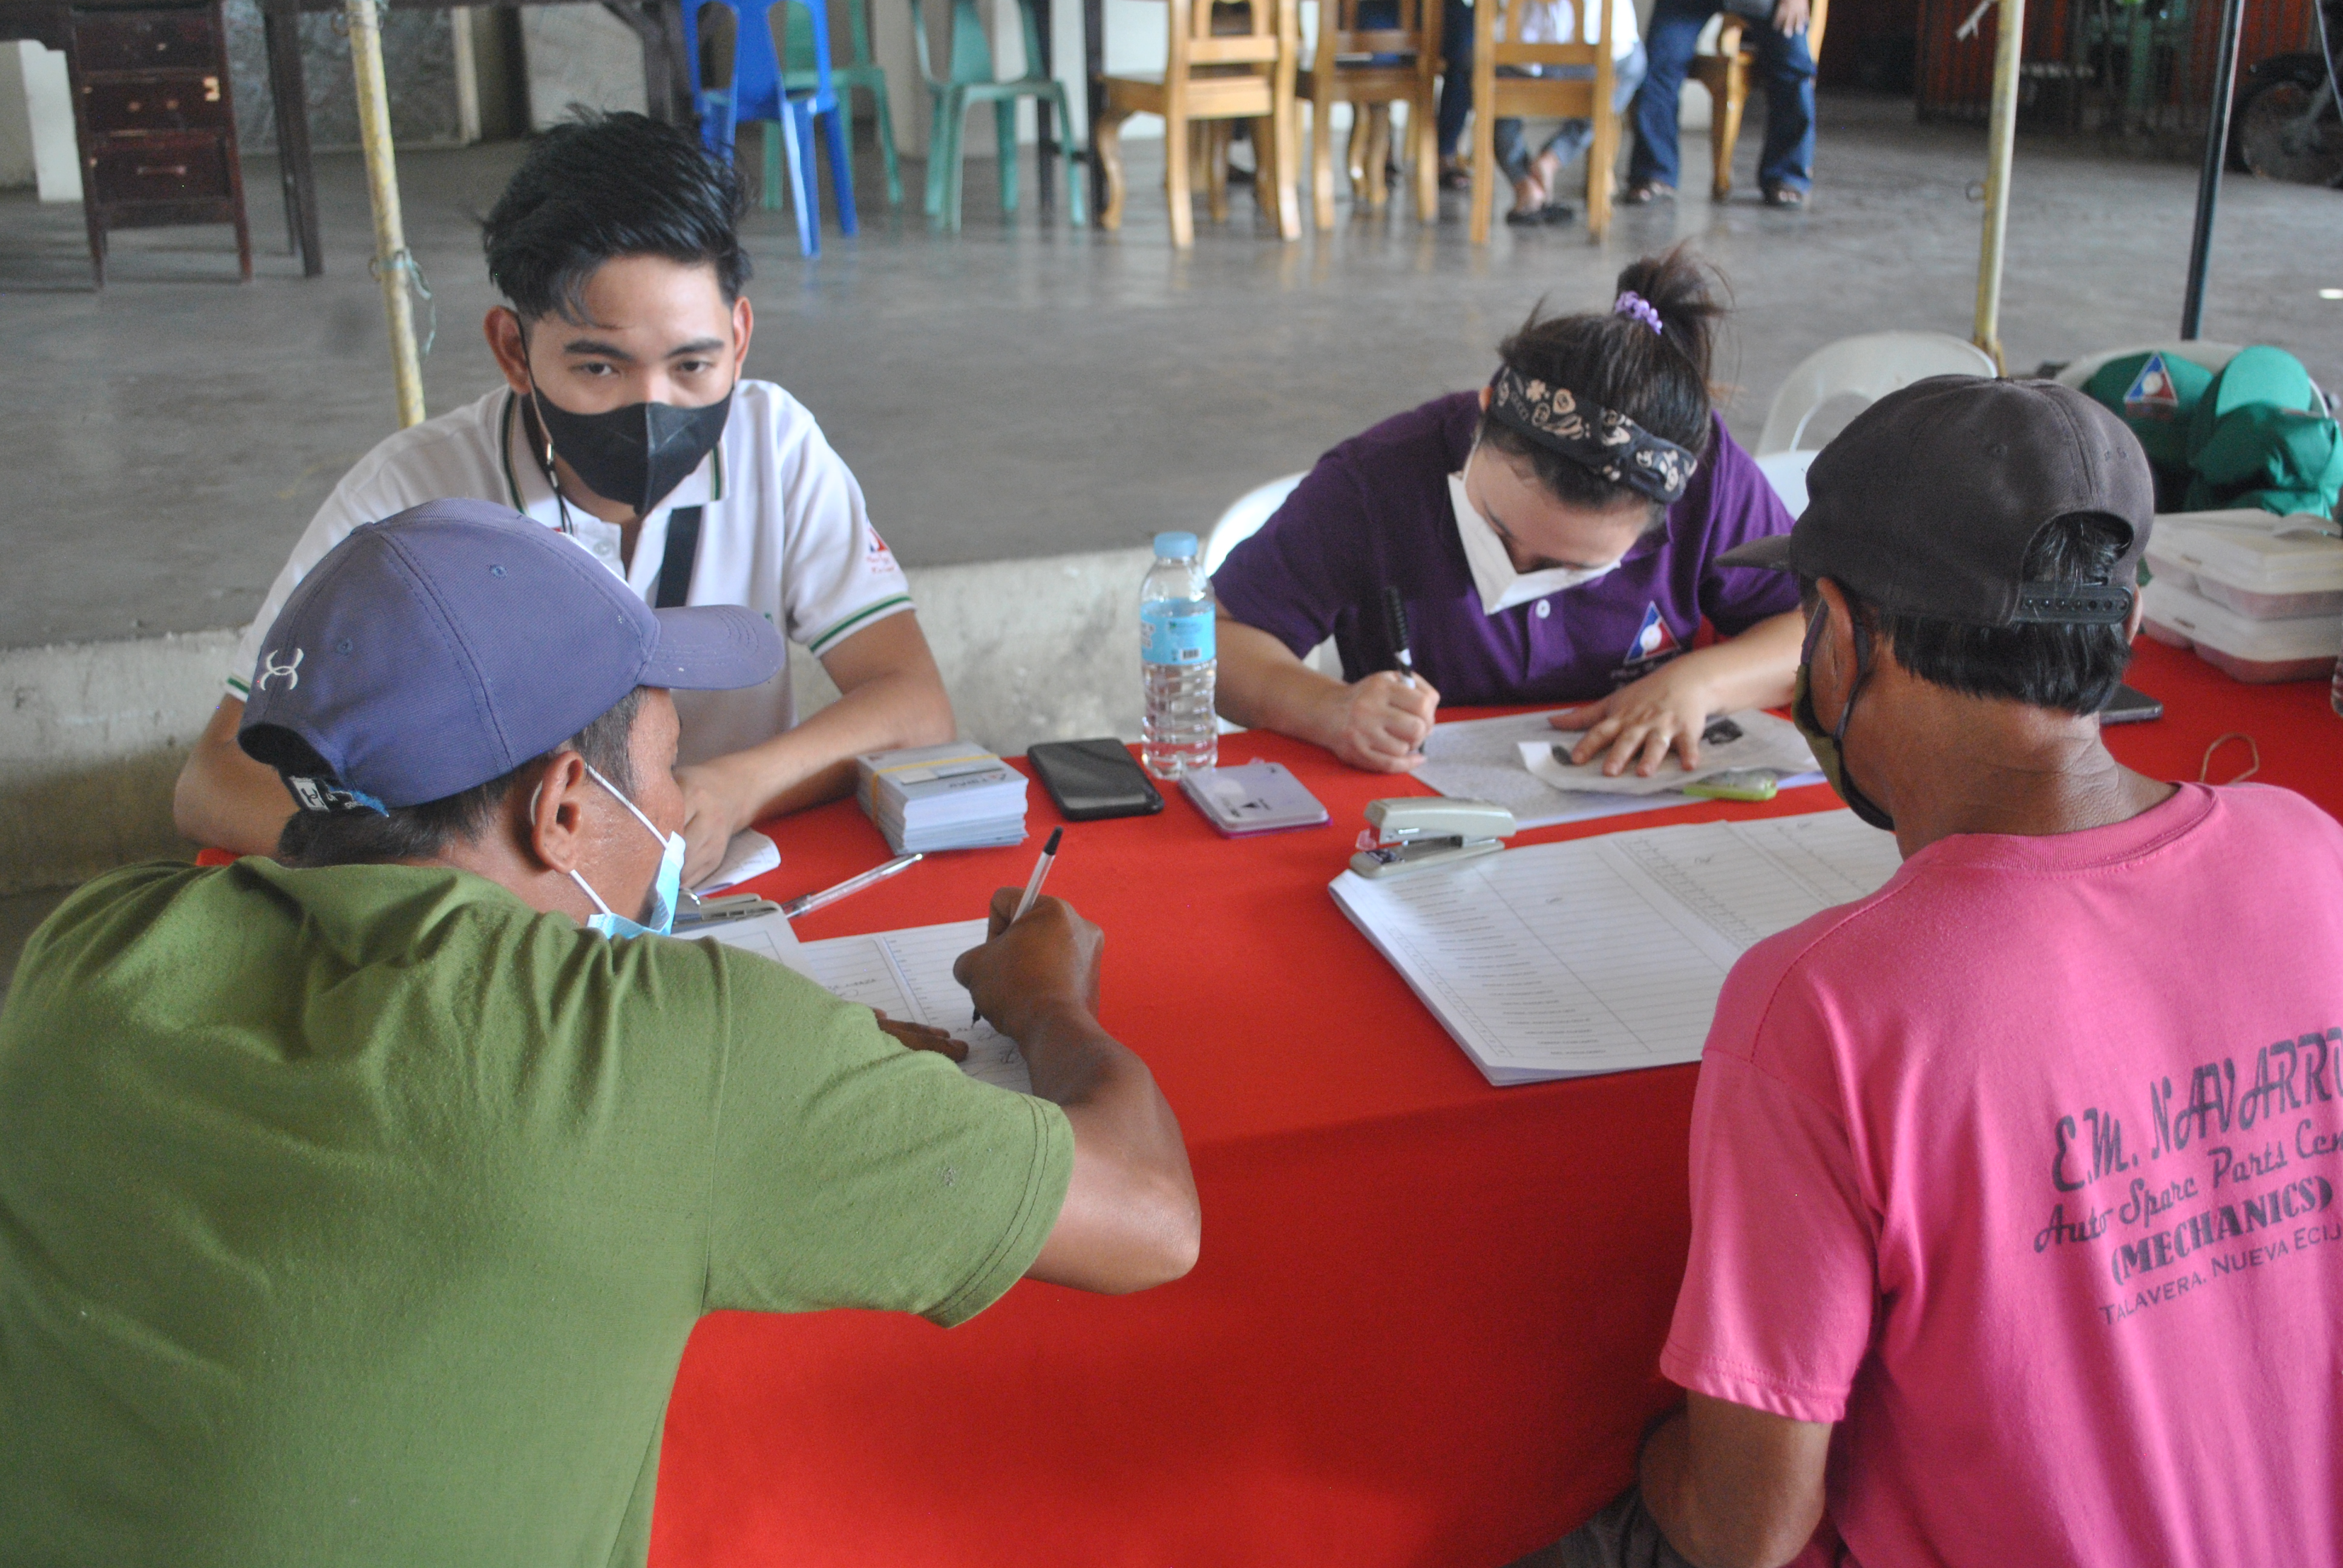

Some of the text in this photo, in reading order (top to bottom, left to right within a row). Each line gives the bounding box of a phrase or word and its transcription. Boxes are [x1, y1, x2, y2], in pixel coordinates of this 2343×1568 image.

[2034, 1204, 2114, 1253] Auto
[2119, 1178, 2198, 1228] Spare
[2207, 1146, 2288, 1188] Parts
[2111, 1175, 2333, 1285] (MECHANICS)
[2211, 1240, 2289, 1277] NUEVA
